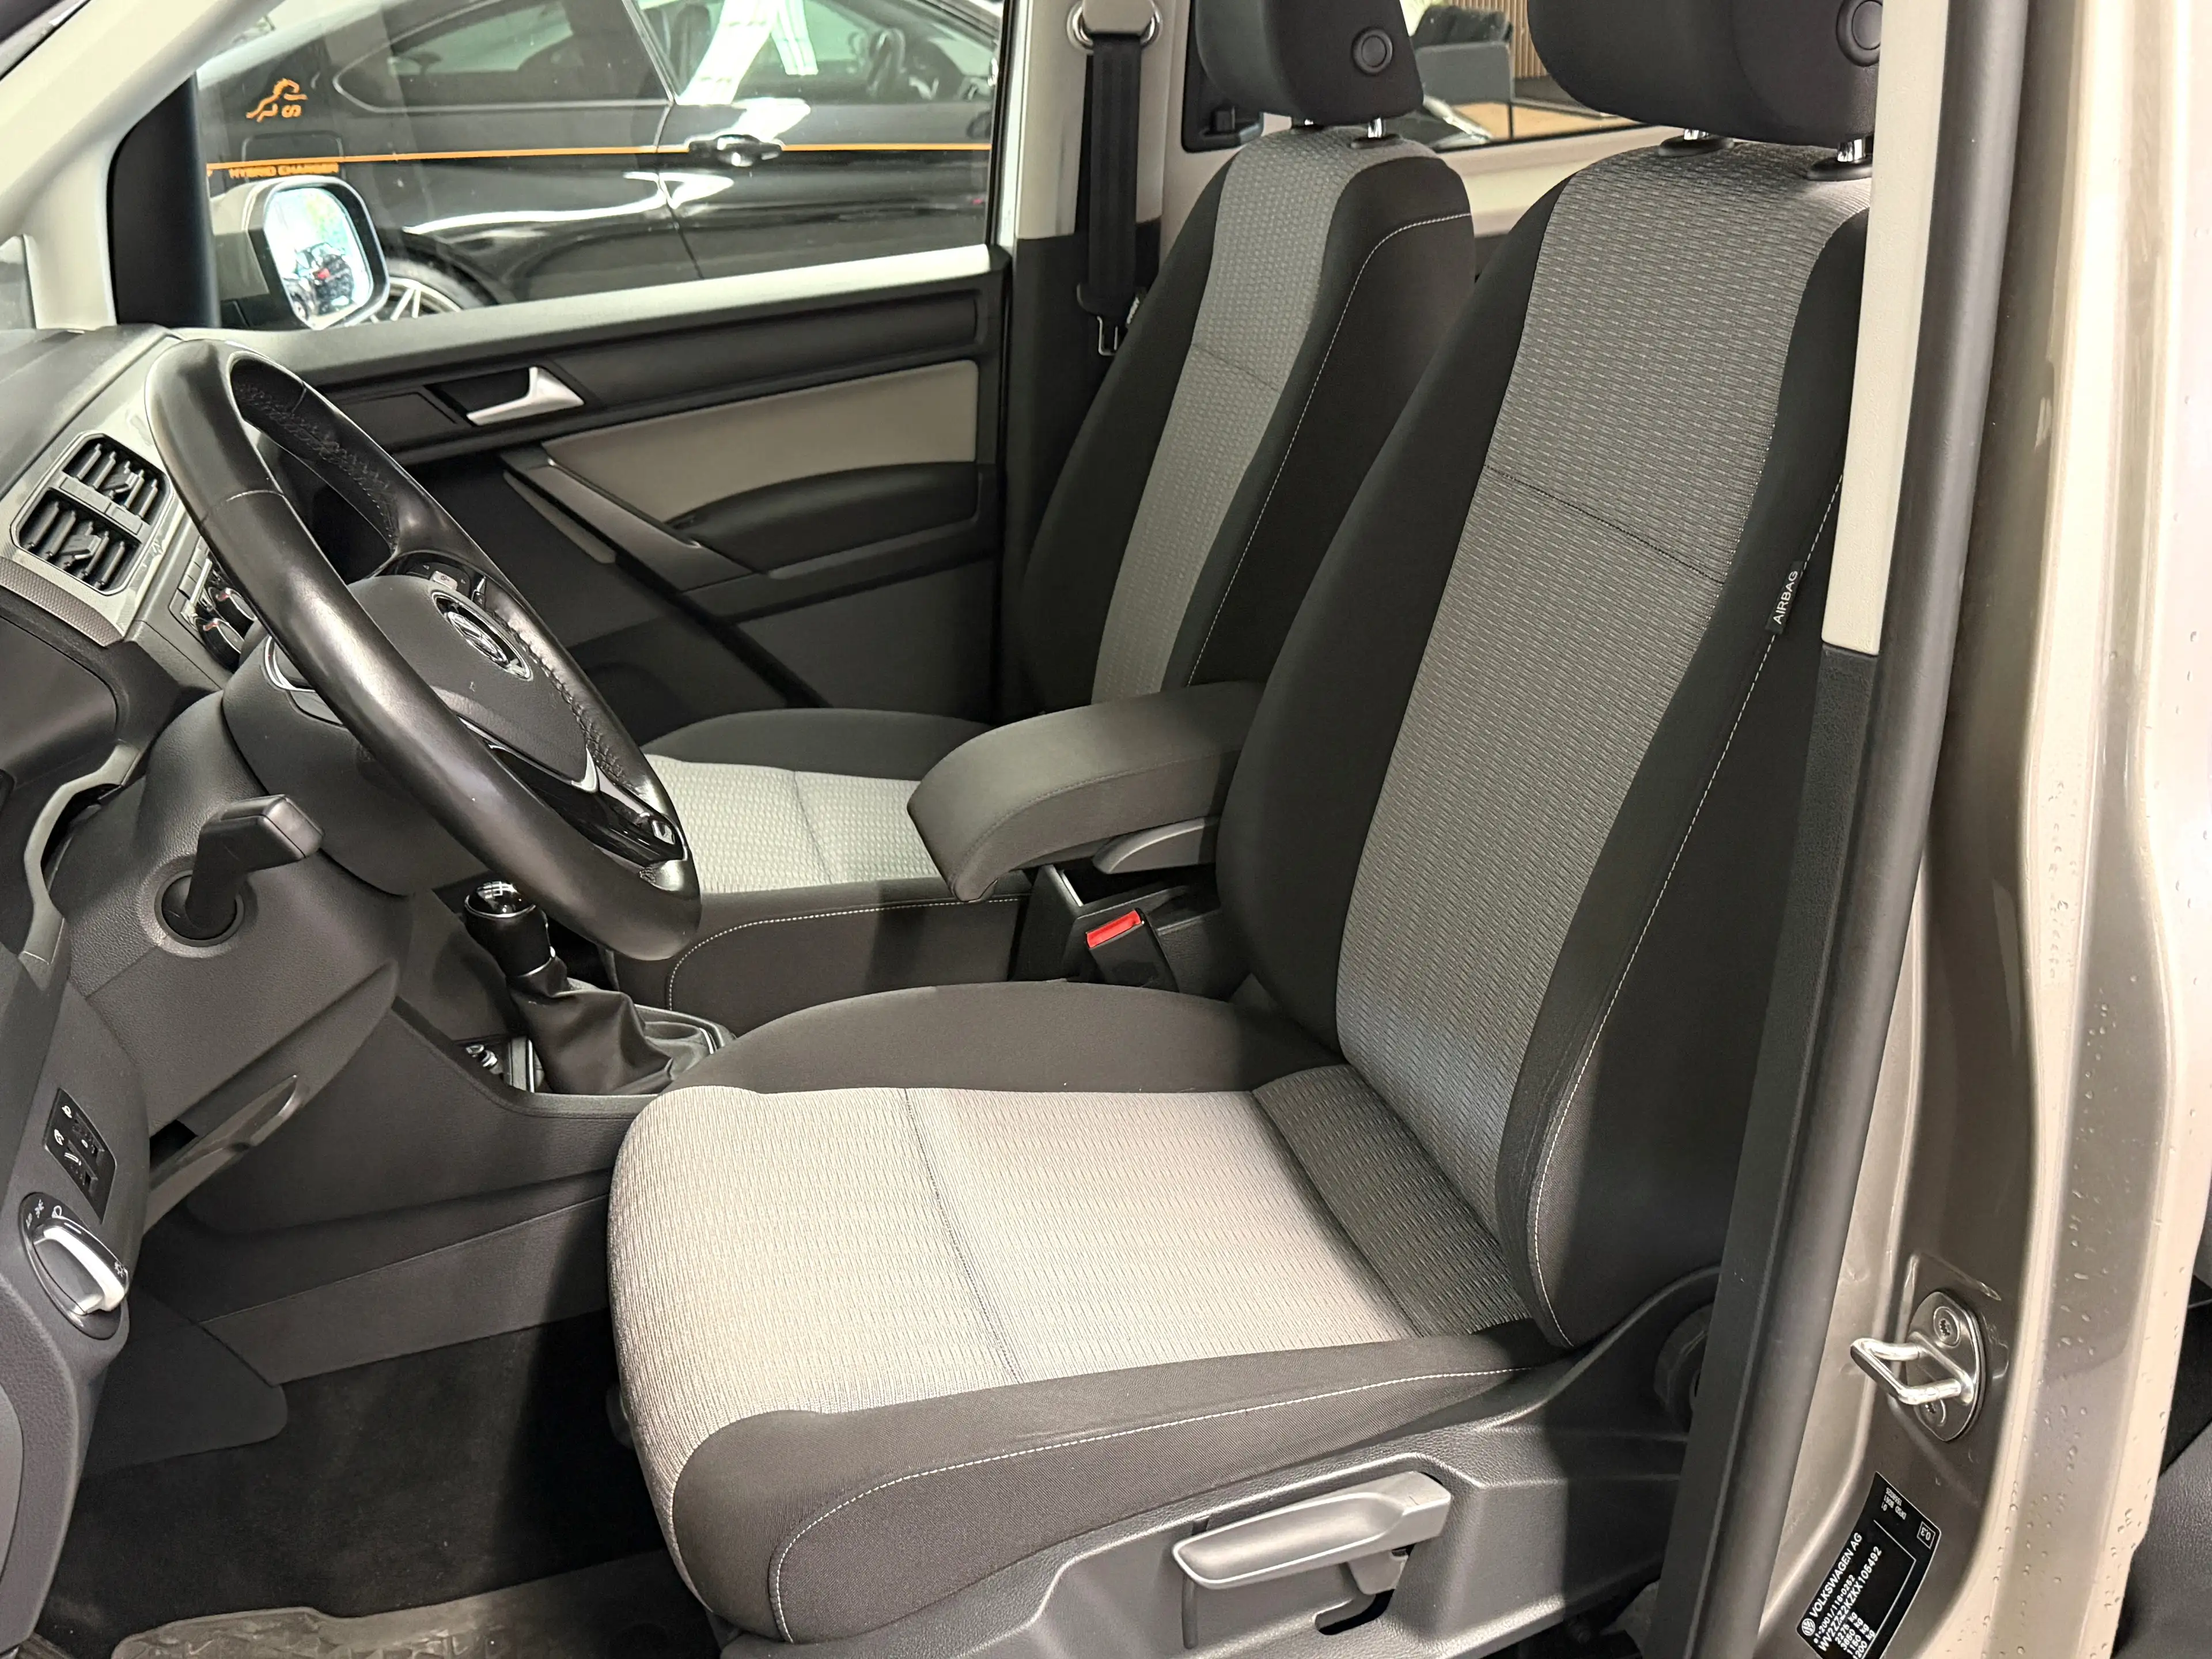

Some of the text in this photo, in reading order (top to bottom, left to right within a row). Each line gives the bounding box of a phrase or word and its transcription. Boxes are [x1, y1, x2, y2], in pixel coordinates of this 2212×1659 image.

[1773, 570, 1798, 625] AIRBAG
[1809, 1550, 1854, 1618] VOLKSWAGEN
[1850, 1532, 1862, 1551] AG
[1848, 1612, 1858, 1623] kg
[1854, 1618, 1864, 1629] kg
[1859, 1623, 1870, 1634] kg
[1866, 1629, 1876, 1641] kg
